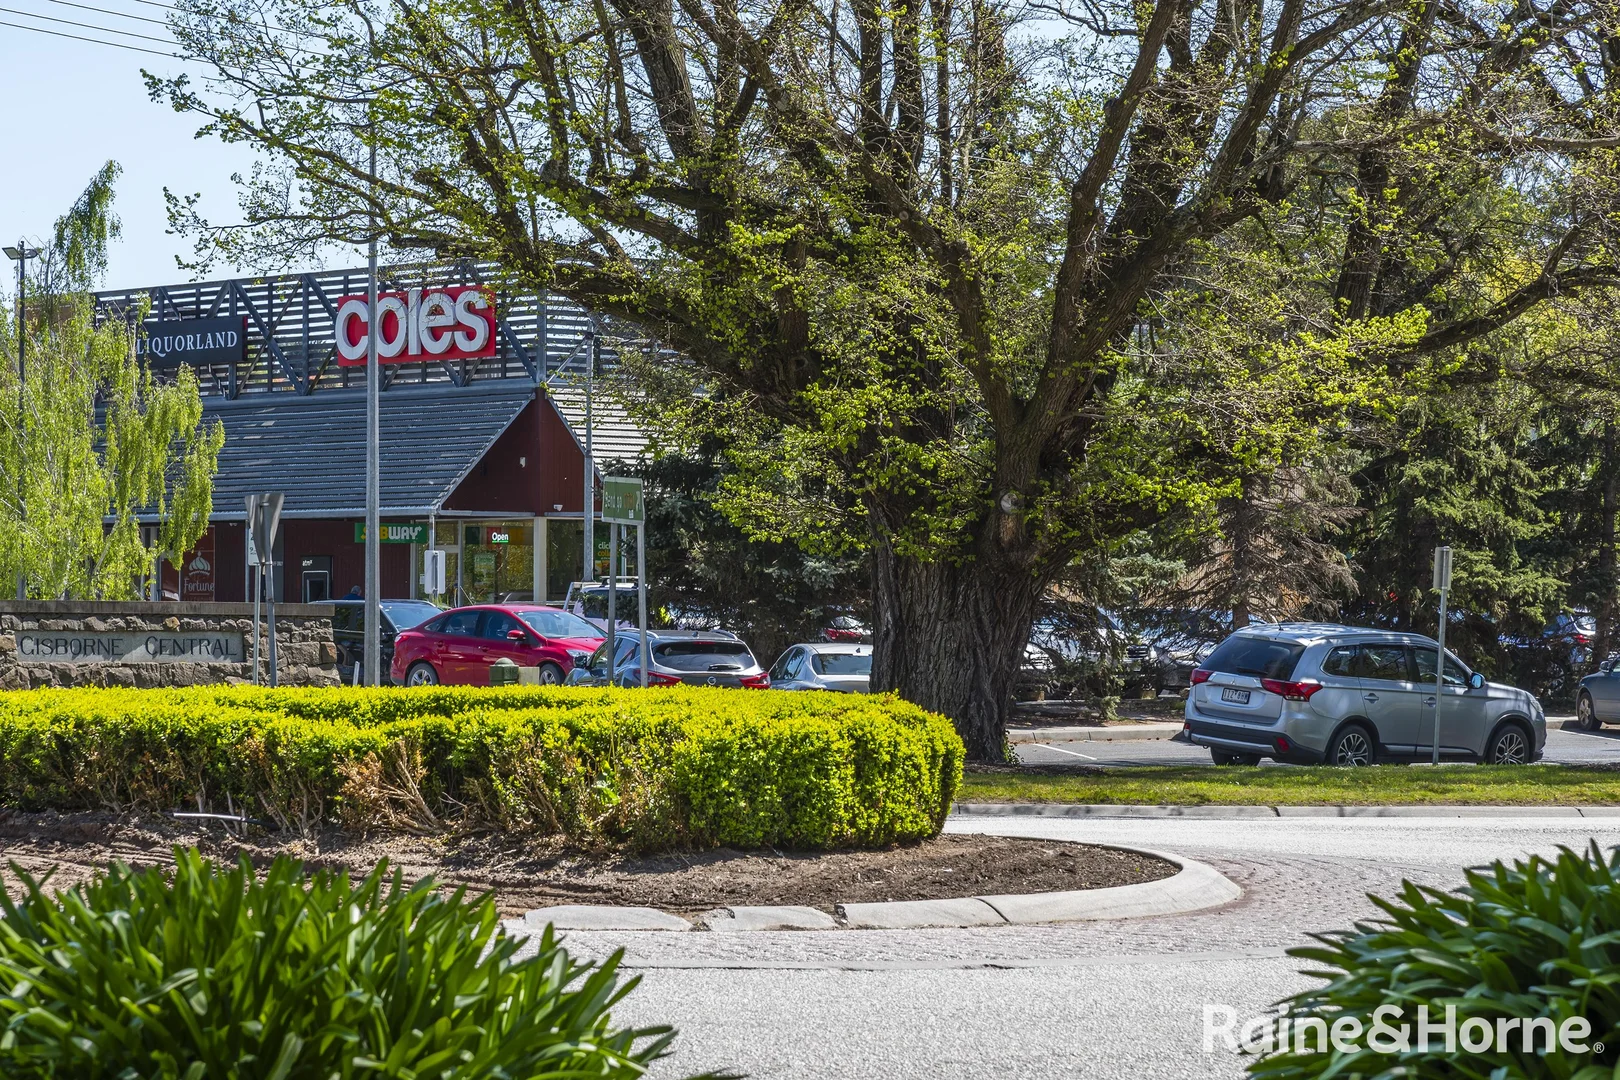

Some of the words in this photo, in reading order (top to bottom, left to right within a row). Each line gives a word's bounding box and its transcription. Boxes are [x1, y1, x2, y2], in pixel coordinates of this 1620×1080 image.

[335, 288, 489, 360] coles
[137, 331, 238, 357] LIQUORLAND
[361, 525, 423, 540] SBWAY
[492, 532, 509, 543] Open
[184, 577, 215, 594] Fortune
[20, 636, 124, 656] GISBORNE
[145, 636, 237, 656] CENTRAL
